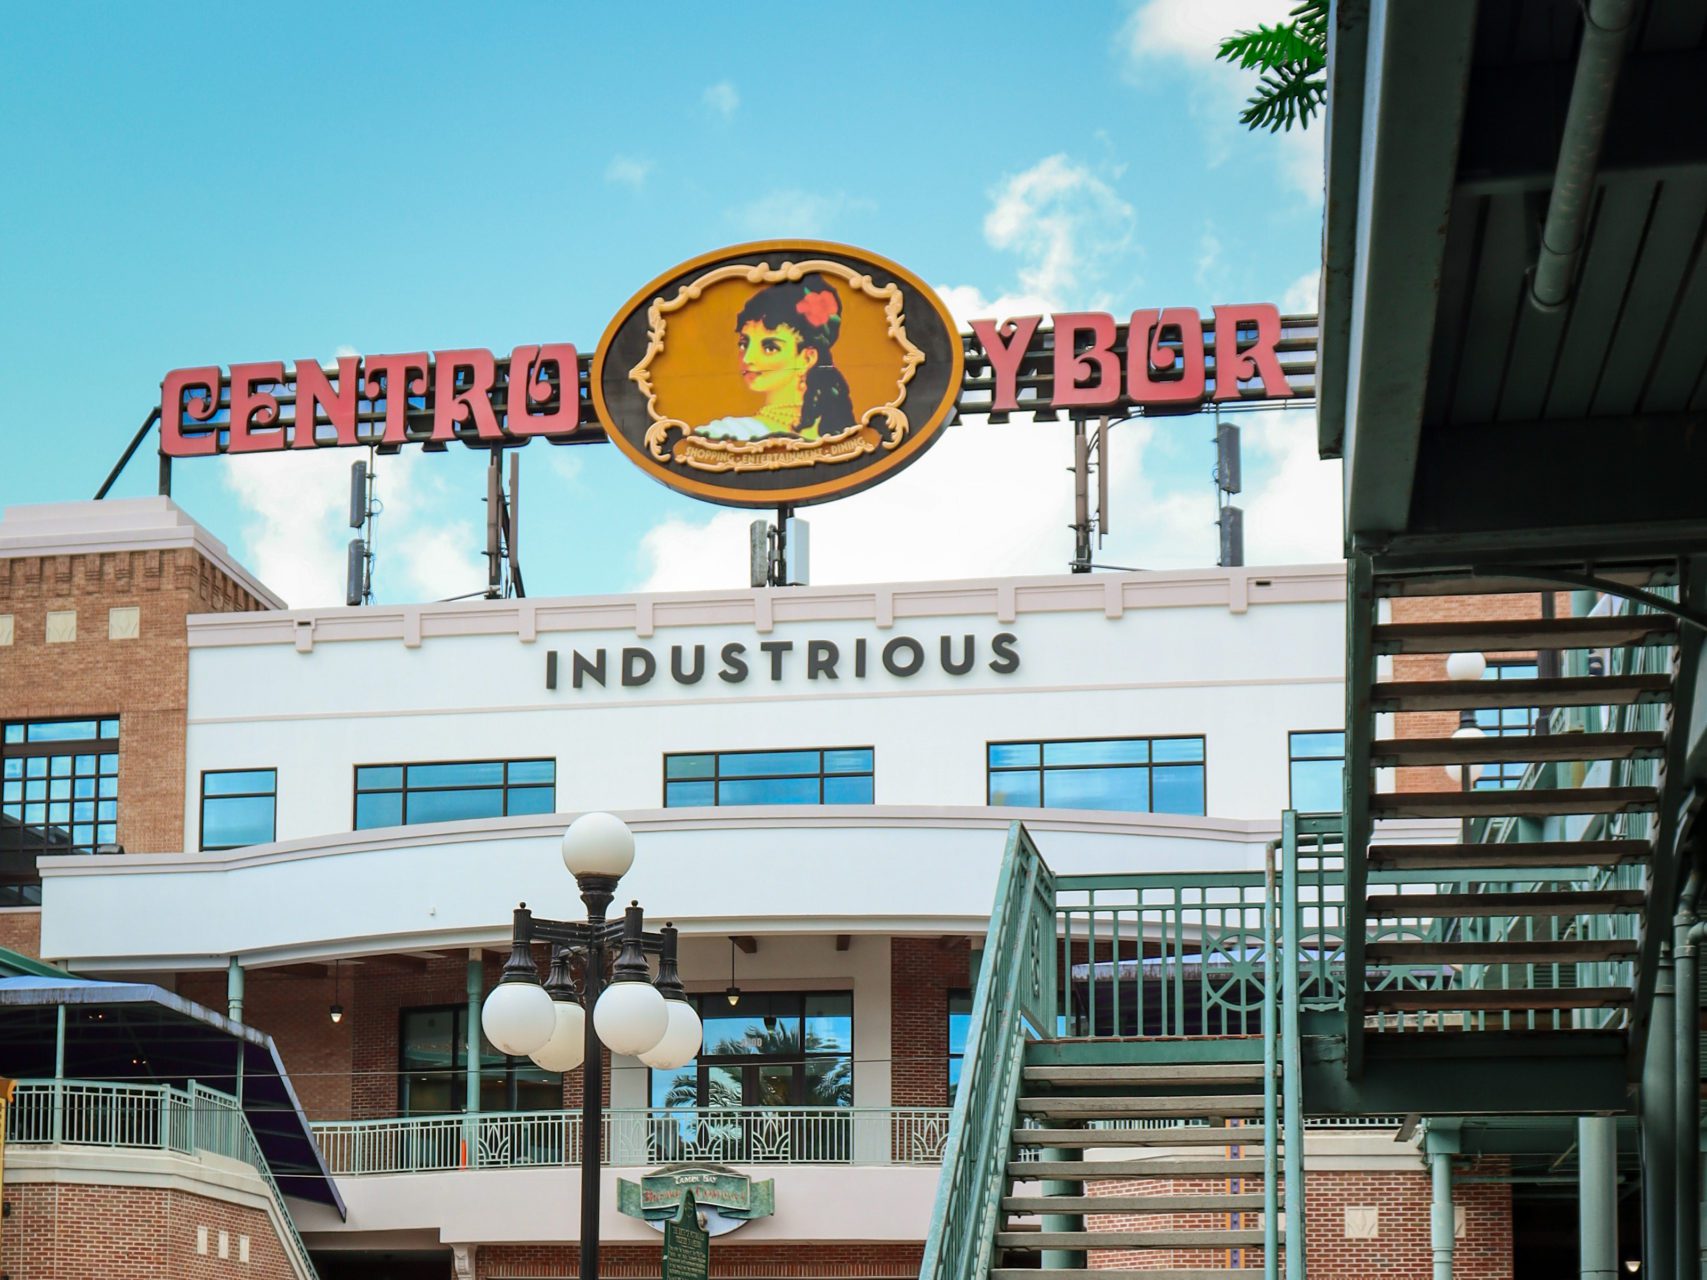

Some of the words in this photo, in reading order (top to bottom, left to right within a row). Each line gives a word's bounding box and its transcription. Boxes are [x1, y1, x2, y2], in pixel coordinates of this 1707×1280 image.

[161, 342, 581, 458] CENTRO
[968, 303, 1293, 412] YBOR
[686, 447, 735, 463] SHOPPING
[742, 449, 823, 464] ENTERTAINMENT
[831, 437, 865, 455] DINING
[546, 632, 1020, 690] INDUSTRIOUS
